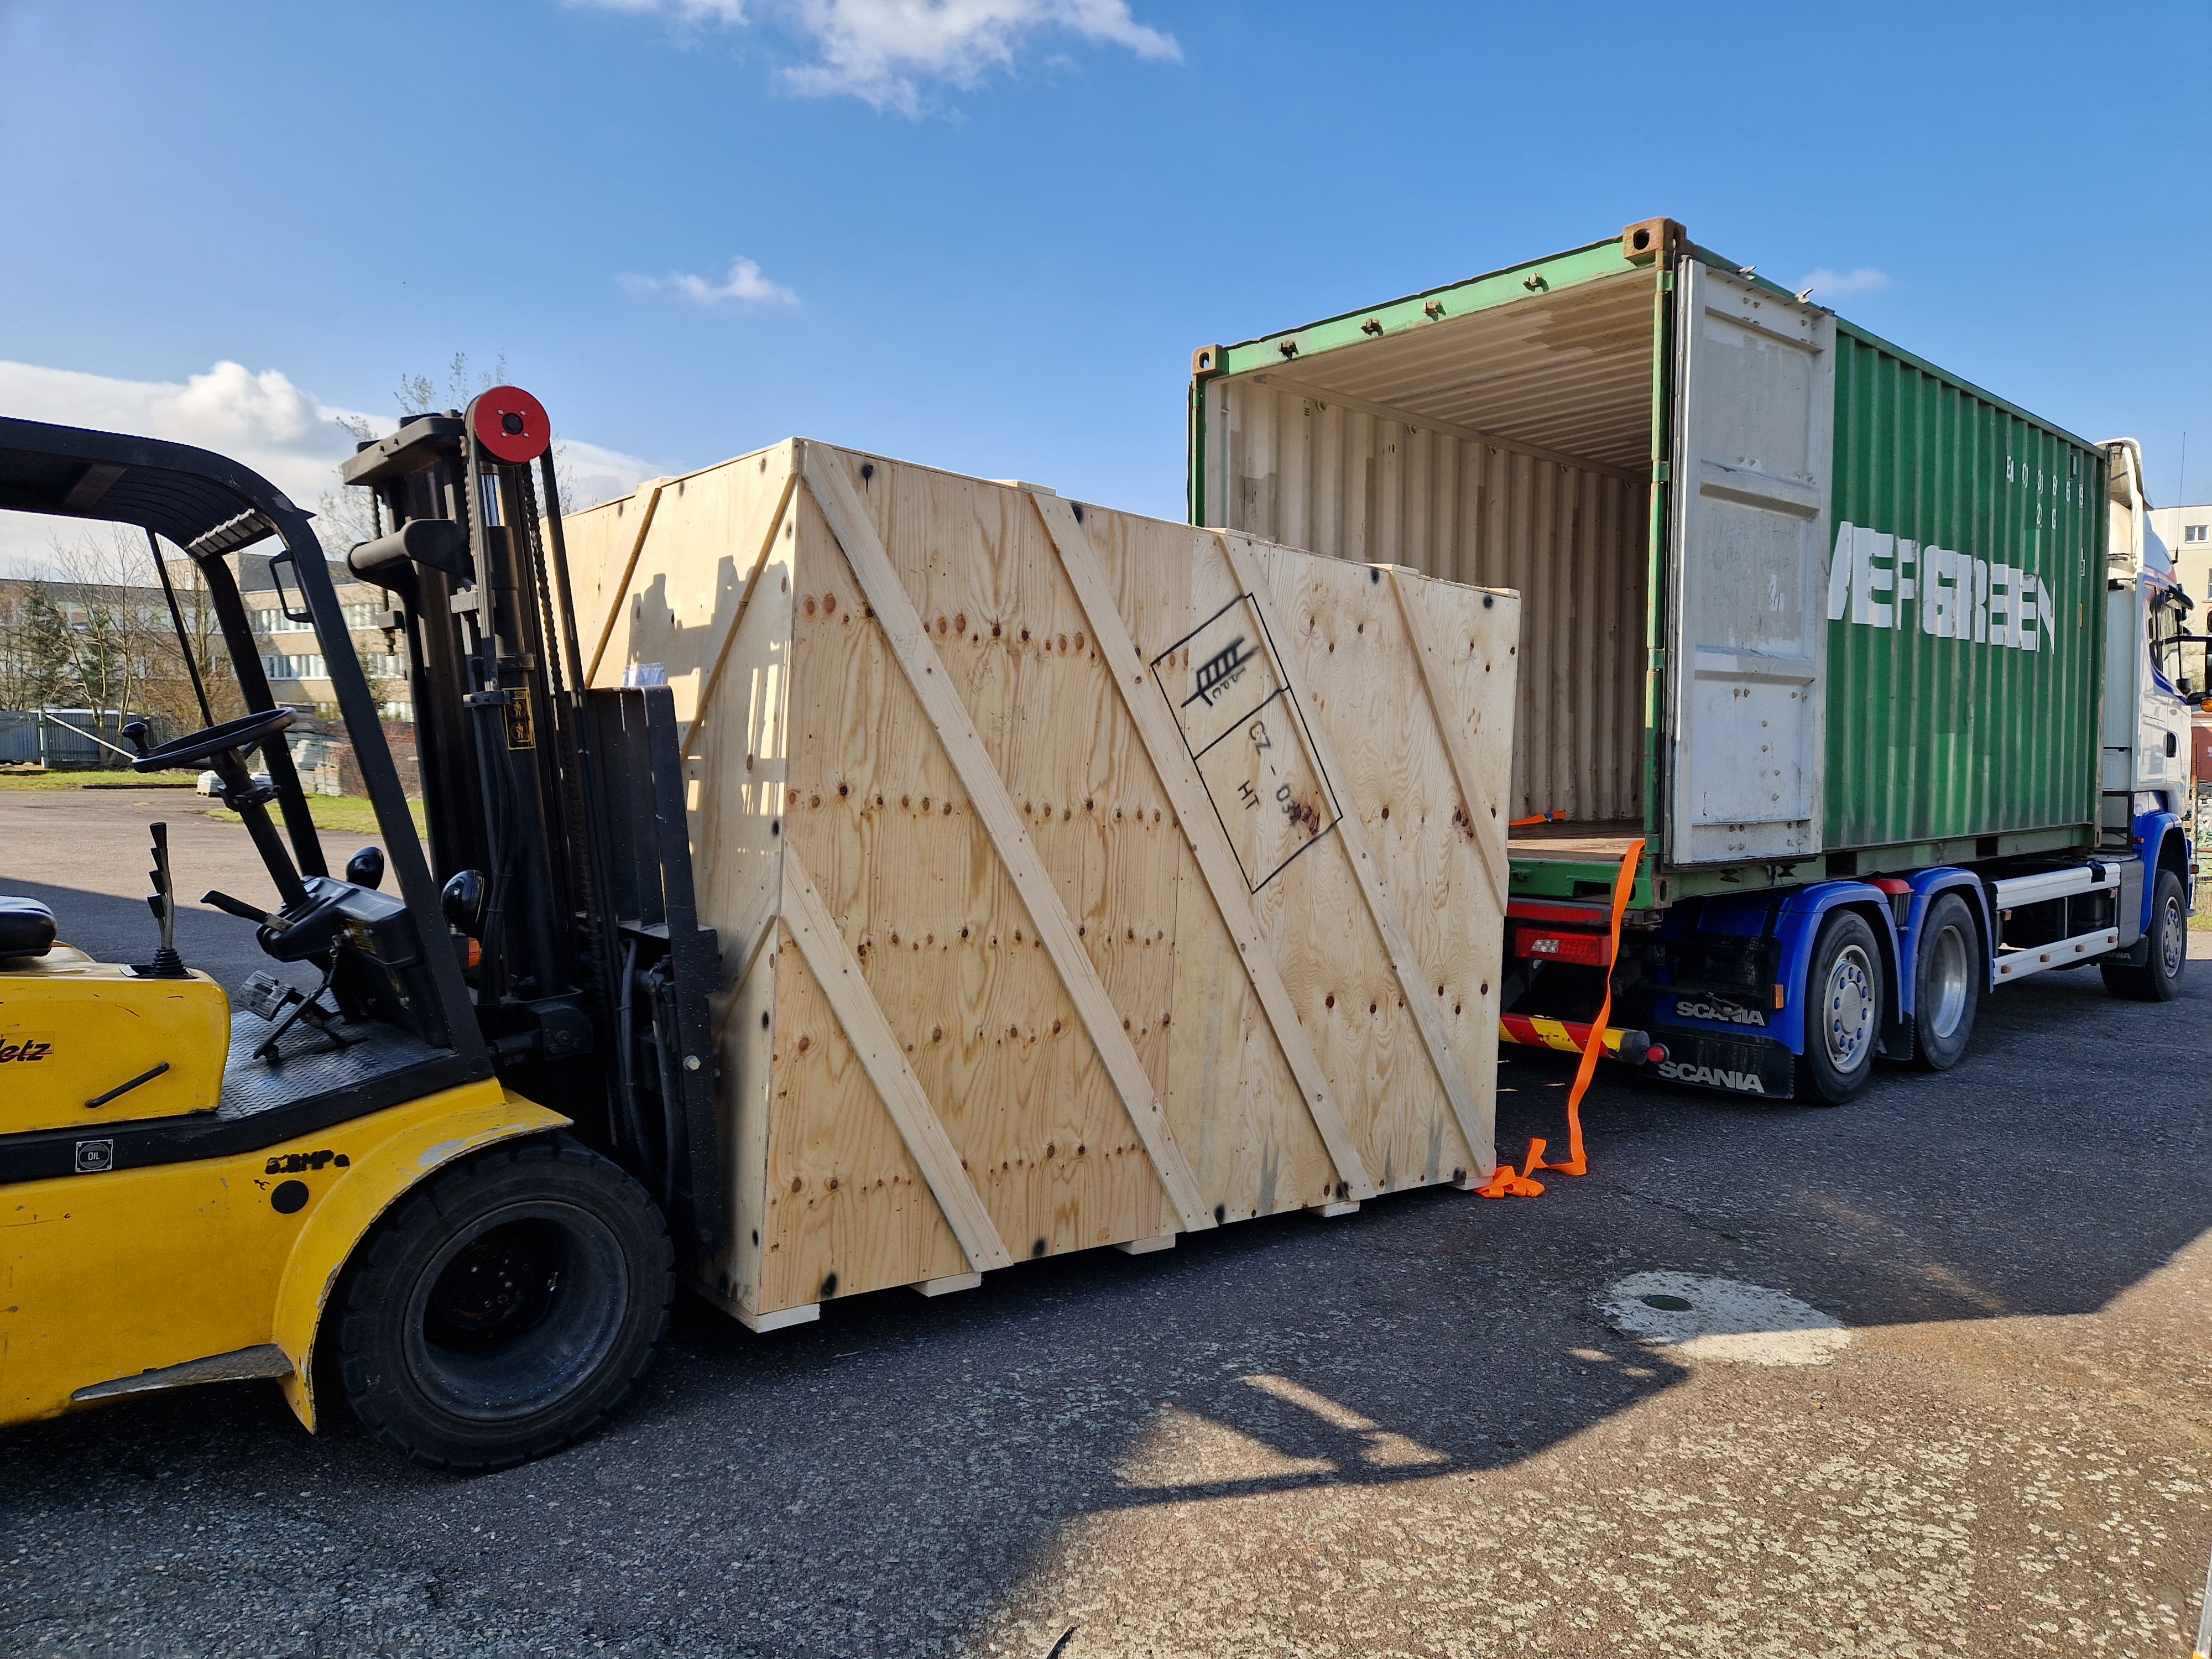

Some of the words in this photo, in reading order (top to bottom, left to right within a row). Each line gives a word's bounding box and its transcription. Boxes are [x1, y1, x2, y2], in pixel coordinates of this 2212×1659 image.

[1249, 721, 1271, 755] CZ
[1238, 780, 1260, 810] HT
[2098, 952, 2132, 960] ANIA
[1676, 1001, 1765, 1026] SCANIA
[1658, 1061, 1765, 1093] SCANIA
[88, 1151, 101, 1161] OIL
